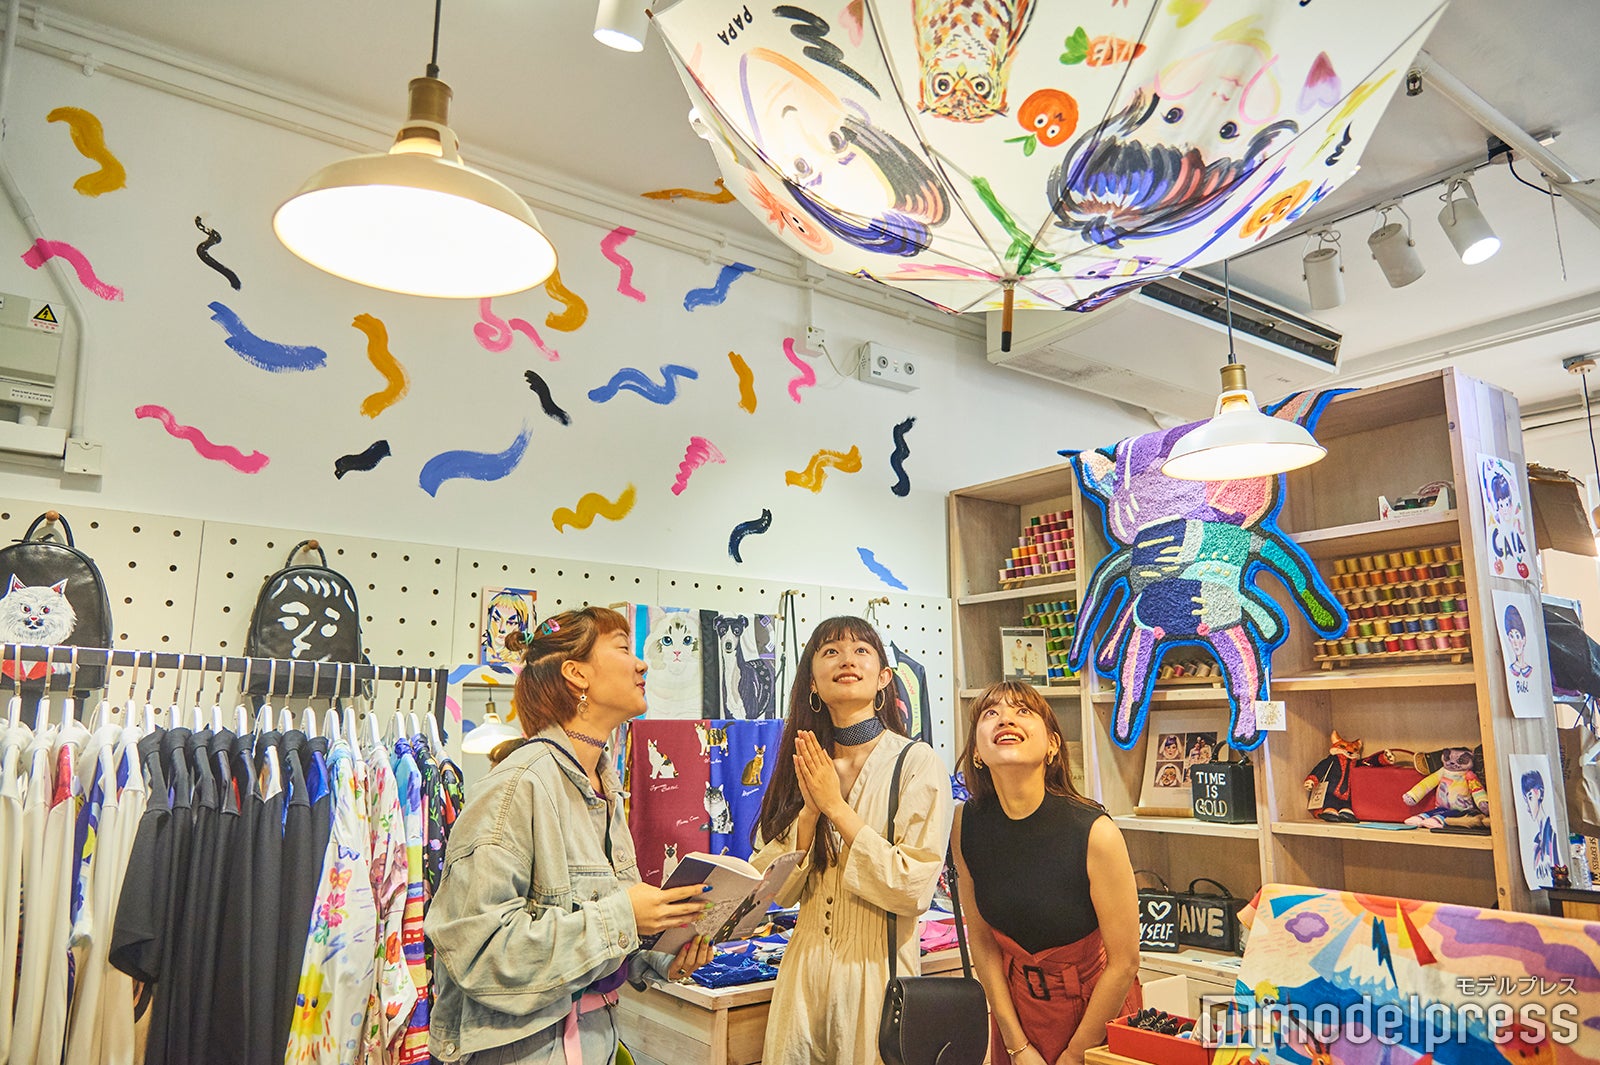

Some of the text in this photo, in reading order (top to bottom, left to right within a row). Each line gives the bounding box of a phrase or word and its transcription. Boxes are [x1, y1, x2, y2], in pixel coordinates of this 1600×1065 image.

[717, 4, 753, 45] PAPA
[1195, 771, 1226, 785] TIME
[1206, 785, 1218, 799] IS
[1195, 798, 1227, 817] GOLD
[1176, 902, 1224, 938] AIVE
[1139, 923, 1174, 940] YSELF
